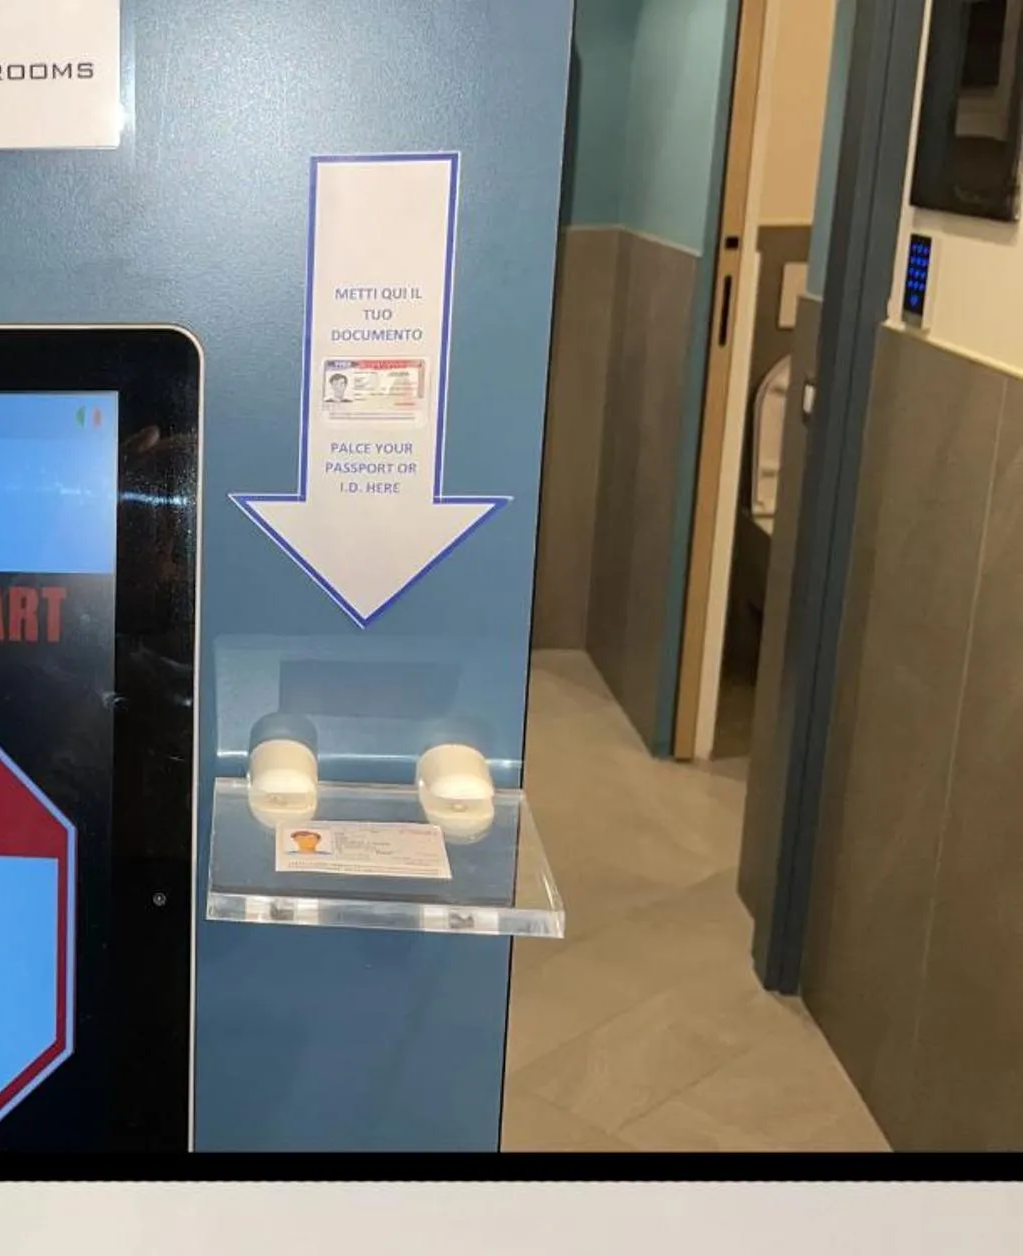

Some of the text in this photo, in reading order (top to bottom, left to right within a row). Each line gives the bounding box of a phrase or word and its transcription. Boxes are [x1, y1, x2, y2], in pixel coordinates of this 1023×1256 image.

[334, 287, 423, 301] METTI QUI IL
[363, 309, 393, 321] TUO
[331, 328, 423, 342] DOCUMENTO
[330, 442, 413, 455] PALCE YOUR
[325, 462, 417, 475] PASSPORT OR
[339, 482, 400, 494] I.D. HERE
